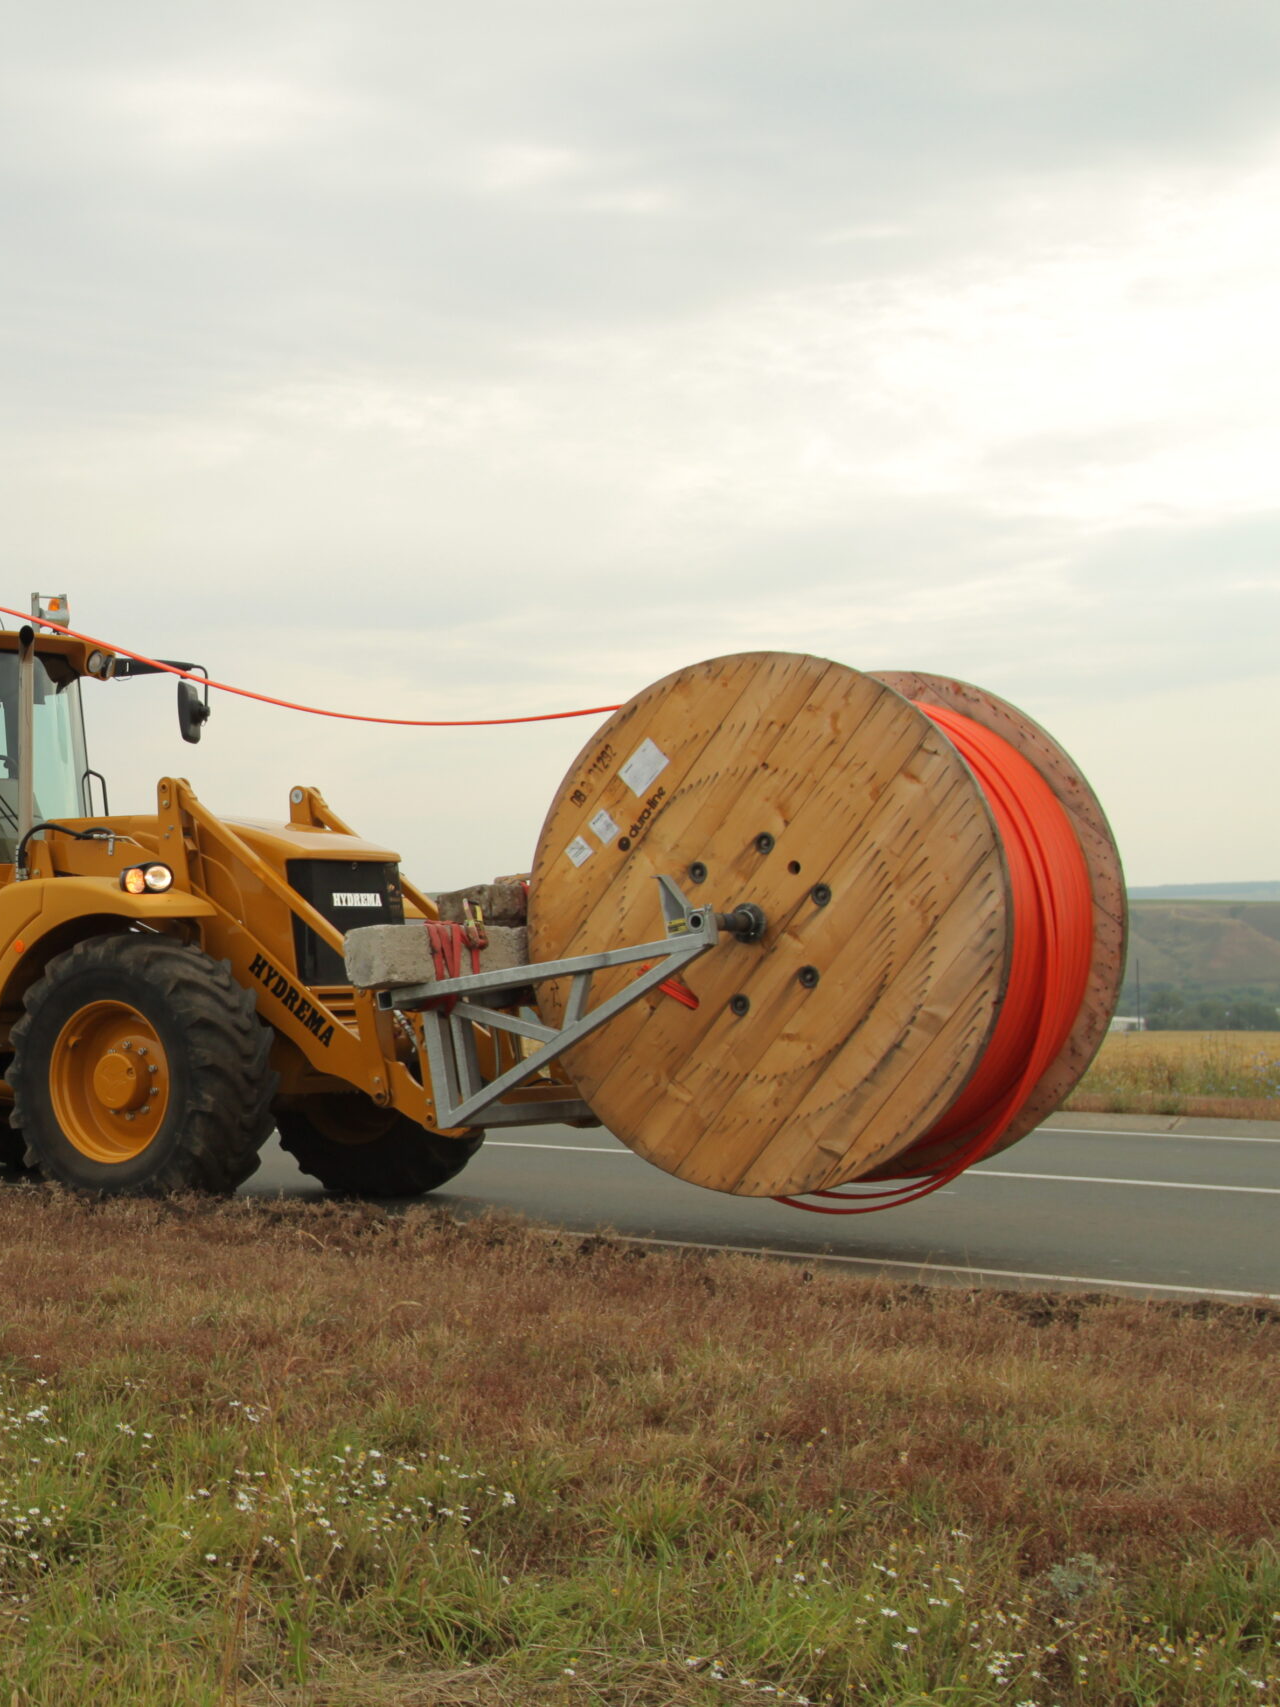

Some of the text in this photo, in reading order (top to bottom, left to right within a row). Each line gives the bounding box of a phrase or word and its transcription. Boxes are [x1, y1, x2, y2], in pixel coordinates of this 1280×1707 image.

[629, 786, 667, 839] dura-line
[331, 892, 383, 908] HYDREMA
[247, 952, 336, 1049] HYDREMA
